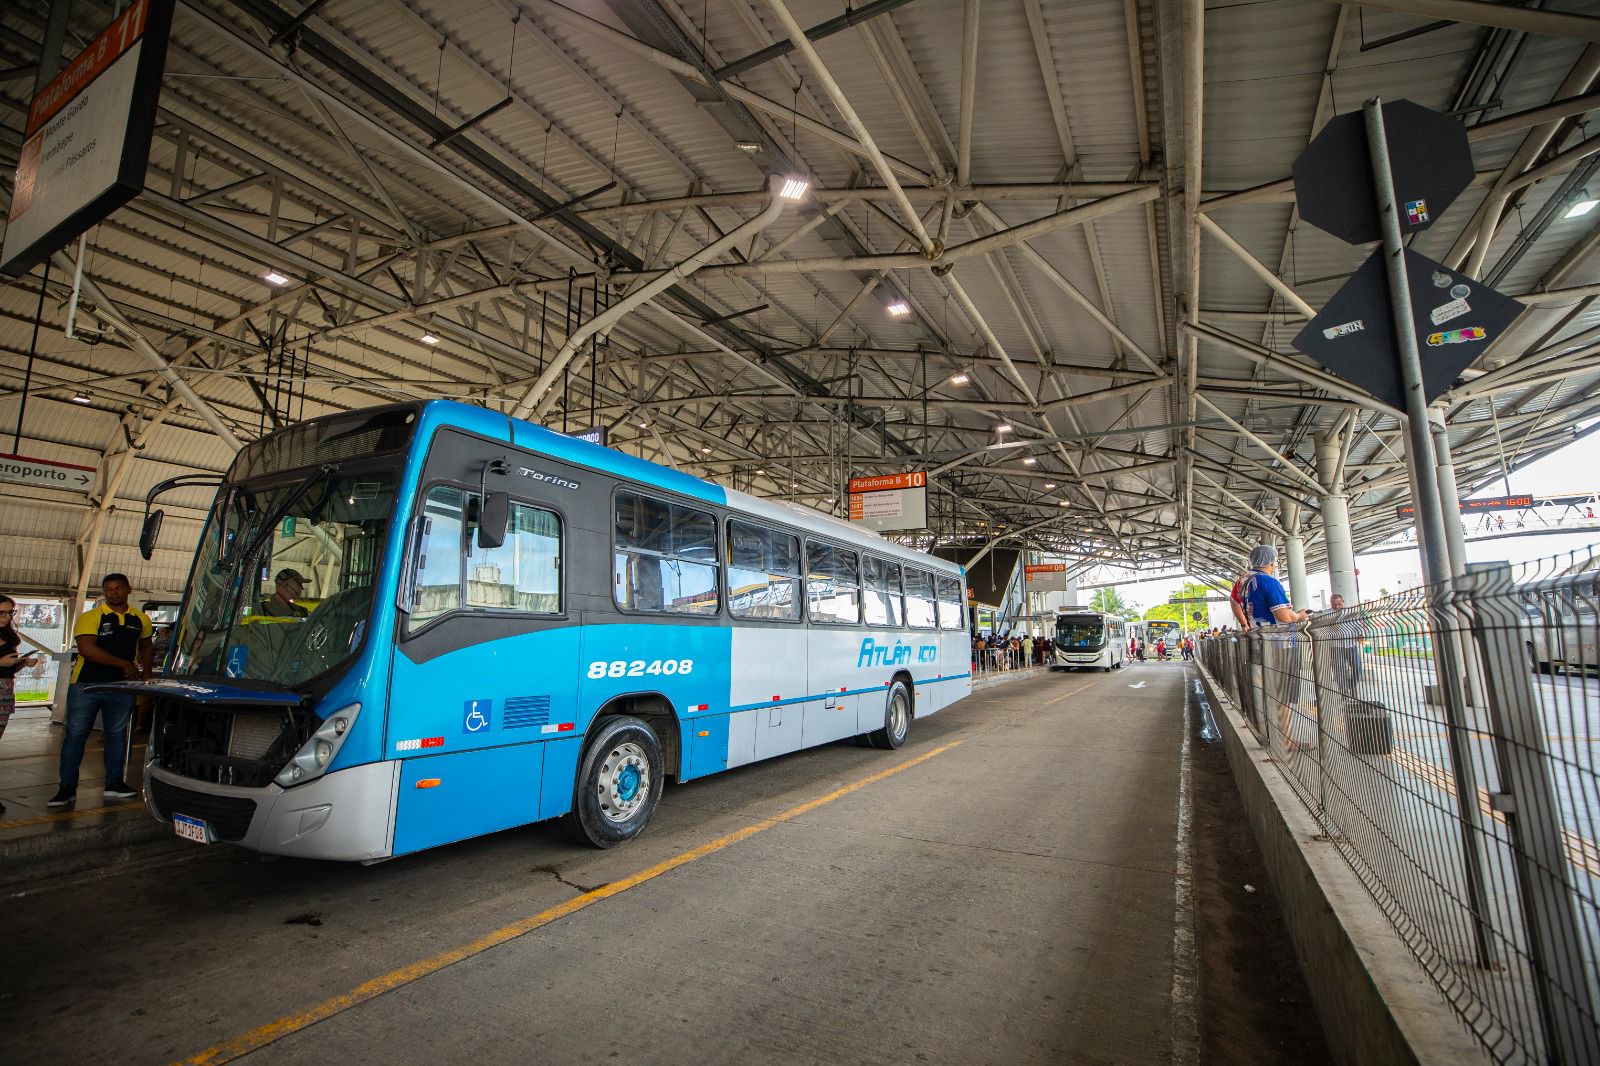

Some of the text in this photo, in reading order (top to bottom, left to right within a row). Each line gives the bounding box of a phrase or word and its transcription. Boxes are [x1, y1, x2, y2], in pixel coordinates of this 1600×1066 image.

[33, 0, 145, 121] Plataforma B 11
[45, 95, 89, 140] Monte Gordo
[0, 463, 67, 481] roporto
[519, 467, 579, 490] Torino
[852, 473, 922, 488] Plataforma B 10
[587, 659, 693, 679] 882408
